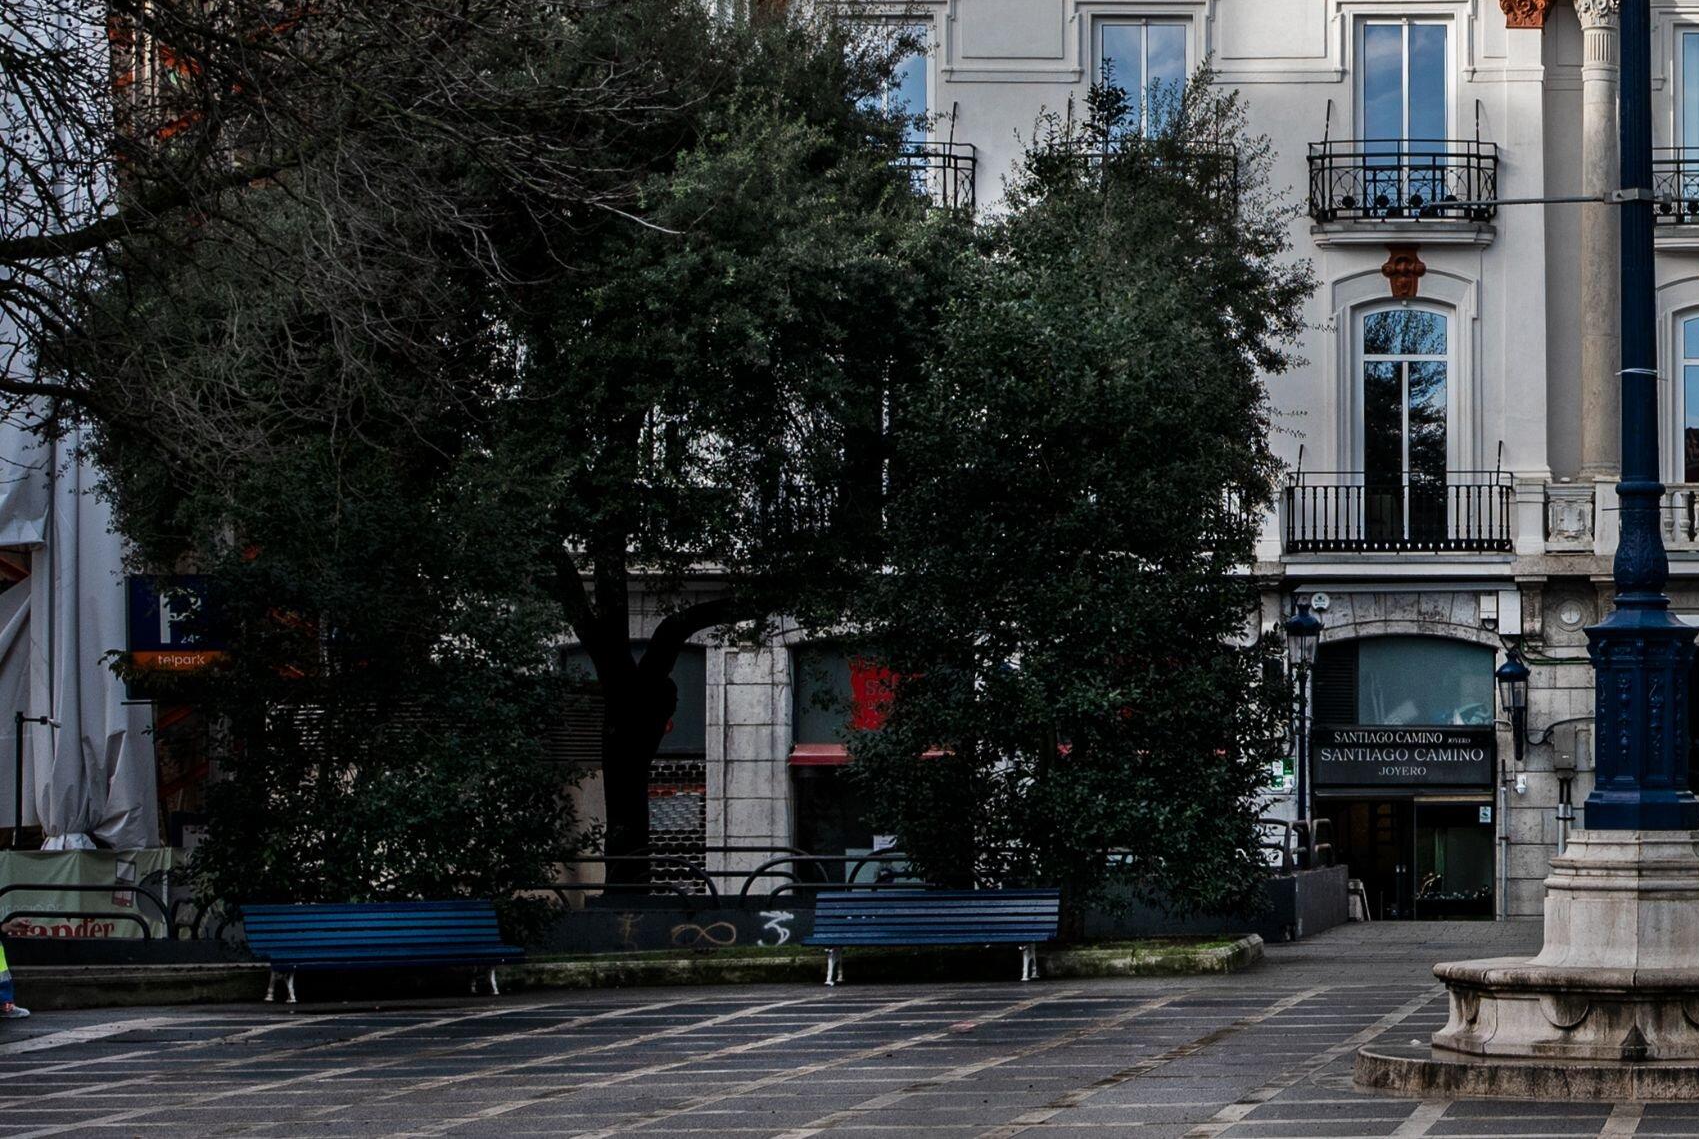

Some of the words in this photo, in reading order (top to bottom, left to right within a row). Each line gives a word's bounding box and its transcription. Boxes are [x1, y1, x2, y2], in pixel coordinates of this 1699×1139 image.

[1334, 731, 1393, 744] SANTIAGO
[1395, 731, 1443, 744] CAMINO
[1321, 748, 1409, 761] SANTIAGO
[1414, 748, 1484, 761] CAMINO
[1378, 766, 1427, 776] JOYERO
